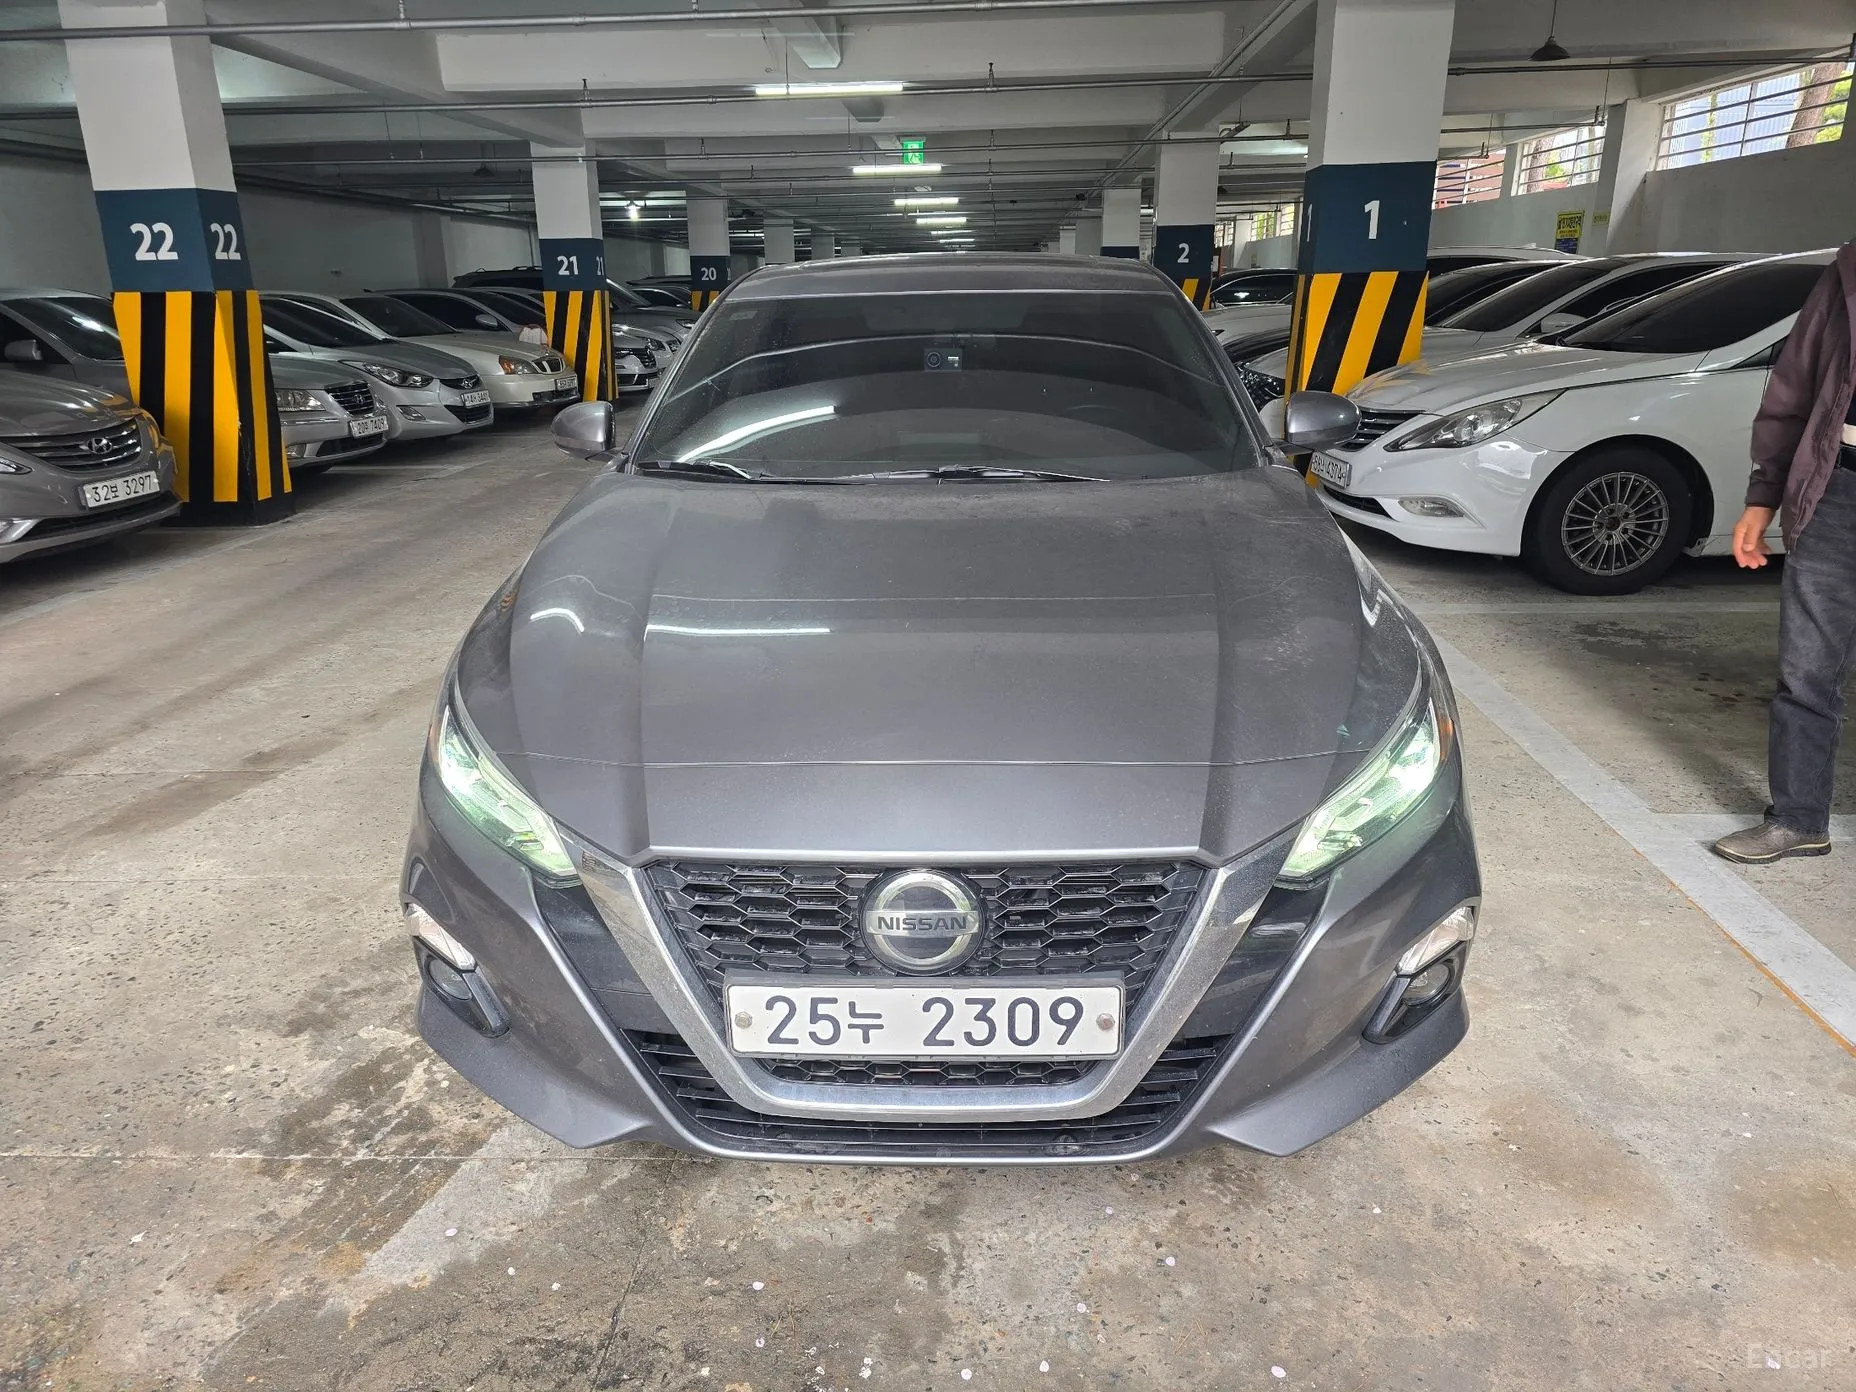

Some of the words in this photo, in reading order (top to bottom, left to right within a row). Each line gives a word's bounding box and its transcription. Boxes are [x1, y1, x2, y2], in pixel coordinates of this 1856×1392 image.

[1364, 199, 1380, 240] 1
[129, 222, 179, 261] 22
[210, 222, 242, 261] 22
[1177, 242, 1191, 264] 2
[557, 255, 579, 276] 21
[700, 267, 717, 281] 20
[92, 484, 120, 502] 32보
[123, 474, 152, 496] 3297
[877, 916, 967, 931] NISSAN
[765, 995, 885, 1046] 25누
[922, 996, 1084, 1047] 2309
